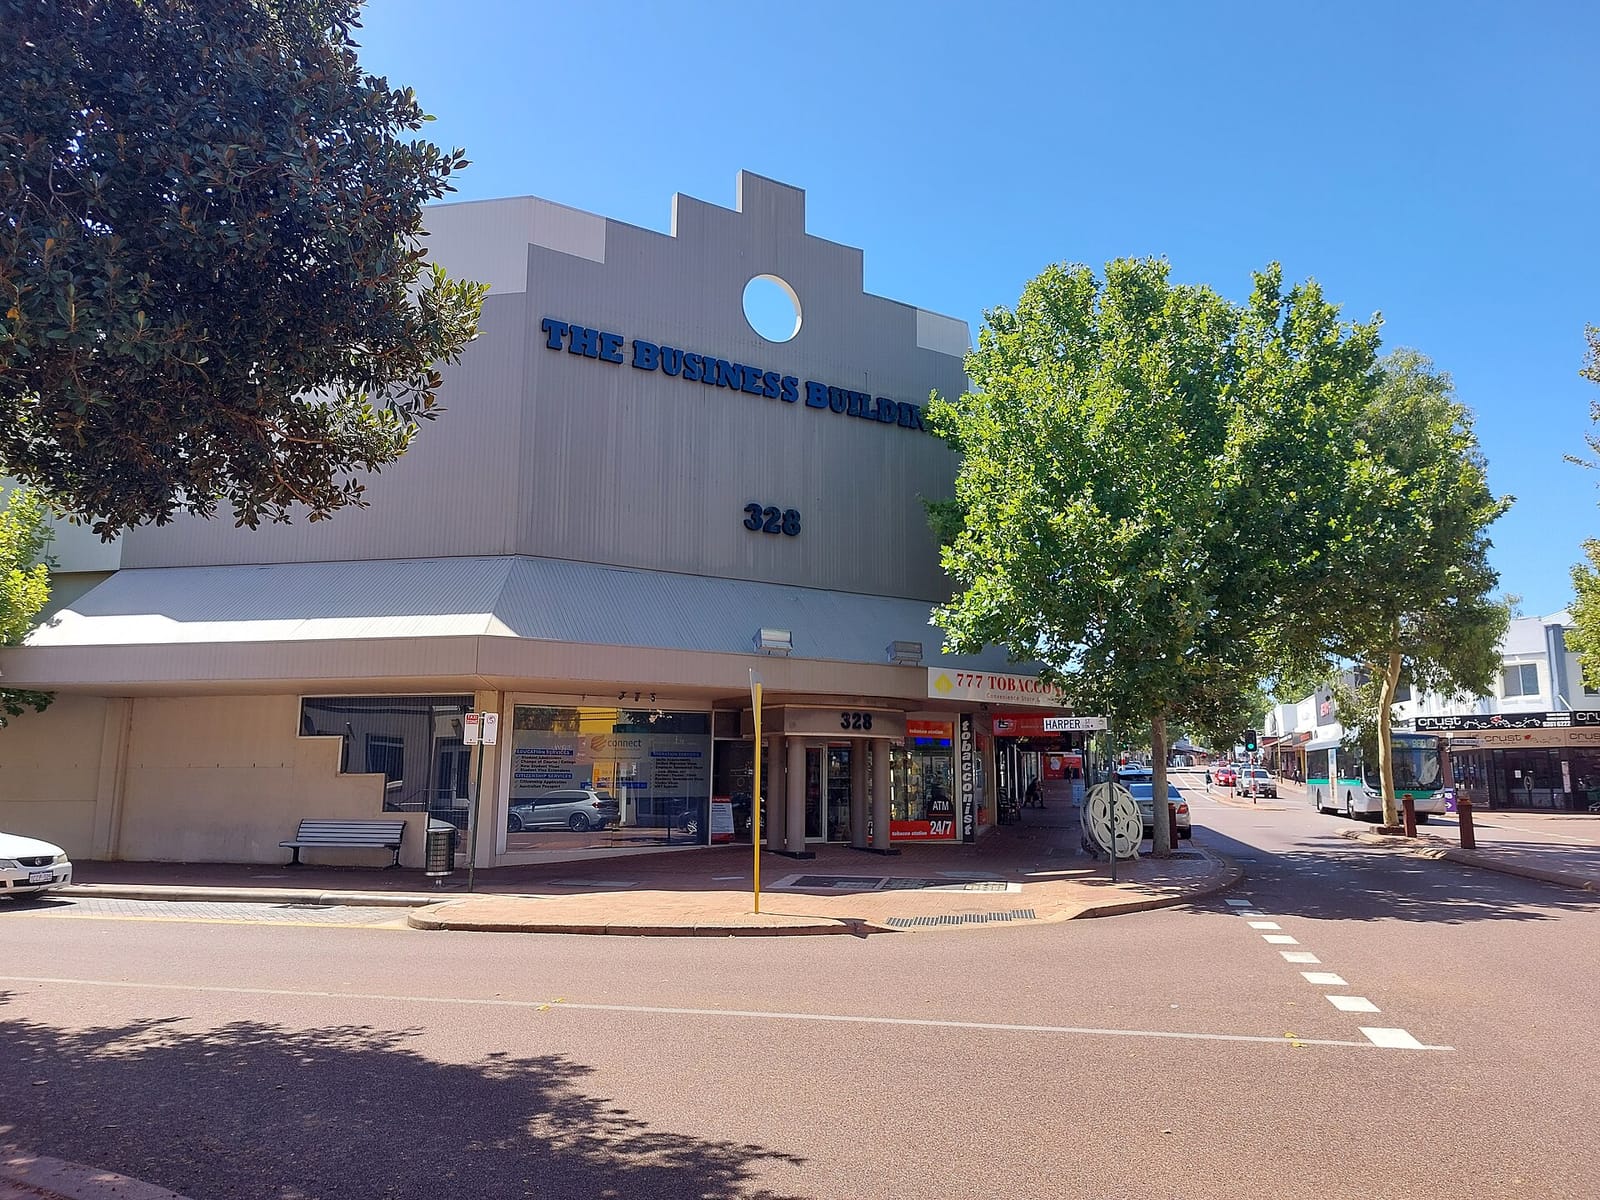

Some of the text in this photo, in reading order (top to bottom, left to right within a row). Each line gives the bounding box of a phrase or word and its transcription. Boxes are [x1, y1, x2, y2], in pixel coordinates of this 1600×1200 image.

[541, 318, 927, 432] THE BUSINESS BUILDIN
[743, 503, 801, 536] 328
[957, 673, 983, 688] 777
[840, 711, 872, 730] 328
[1045, 719, 1081, 729] HARPER
[1418, 716, 1462, 726] crust
[607, 739, 642, 748] connect
[1484, 734, 1522, 742] crust
[961, 720, 973, 835] tobacconist
[932, 801, 949, 811] ATM
[930, 820, 952, 835] 24/7
